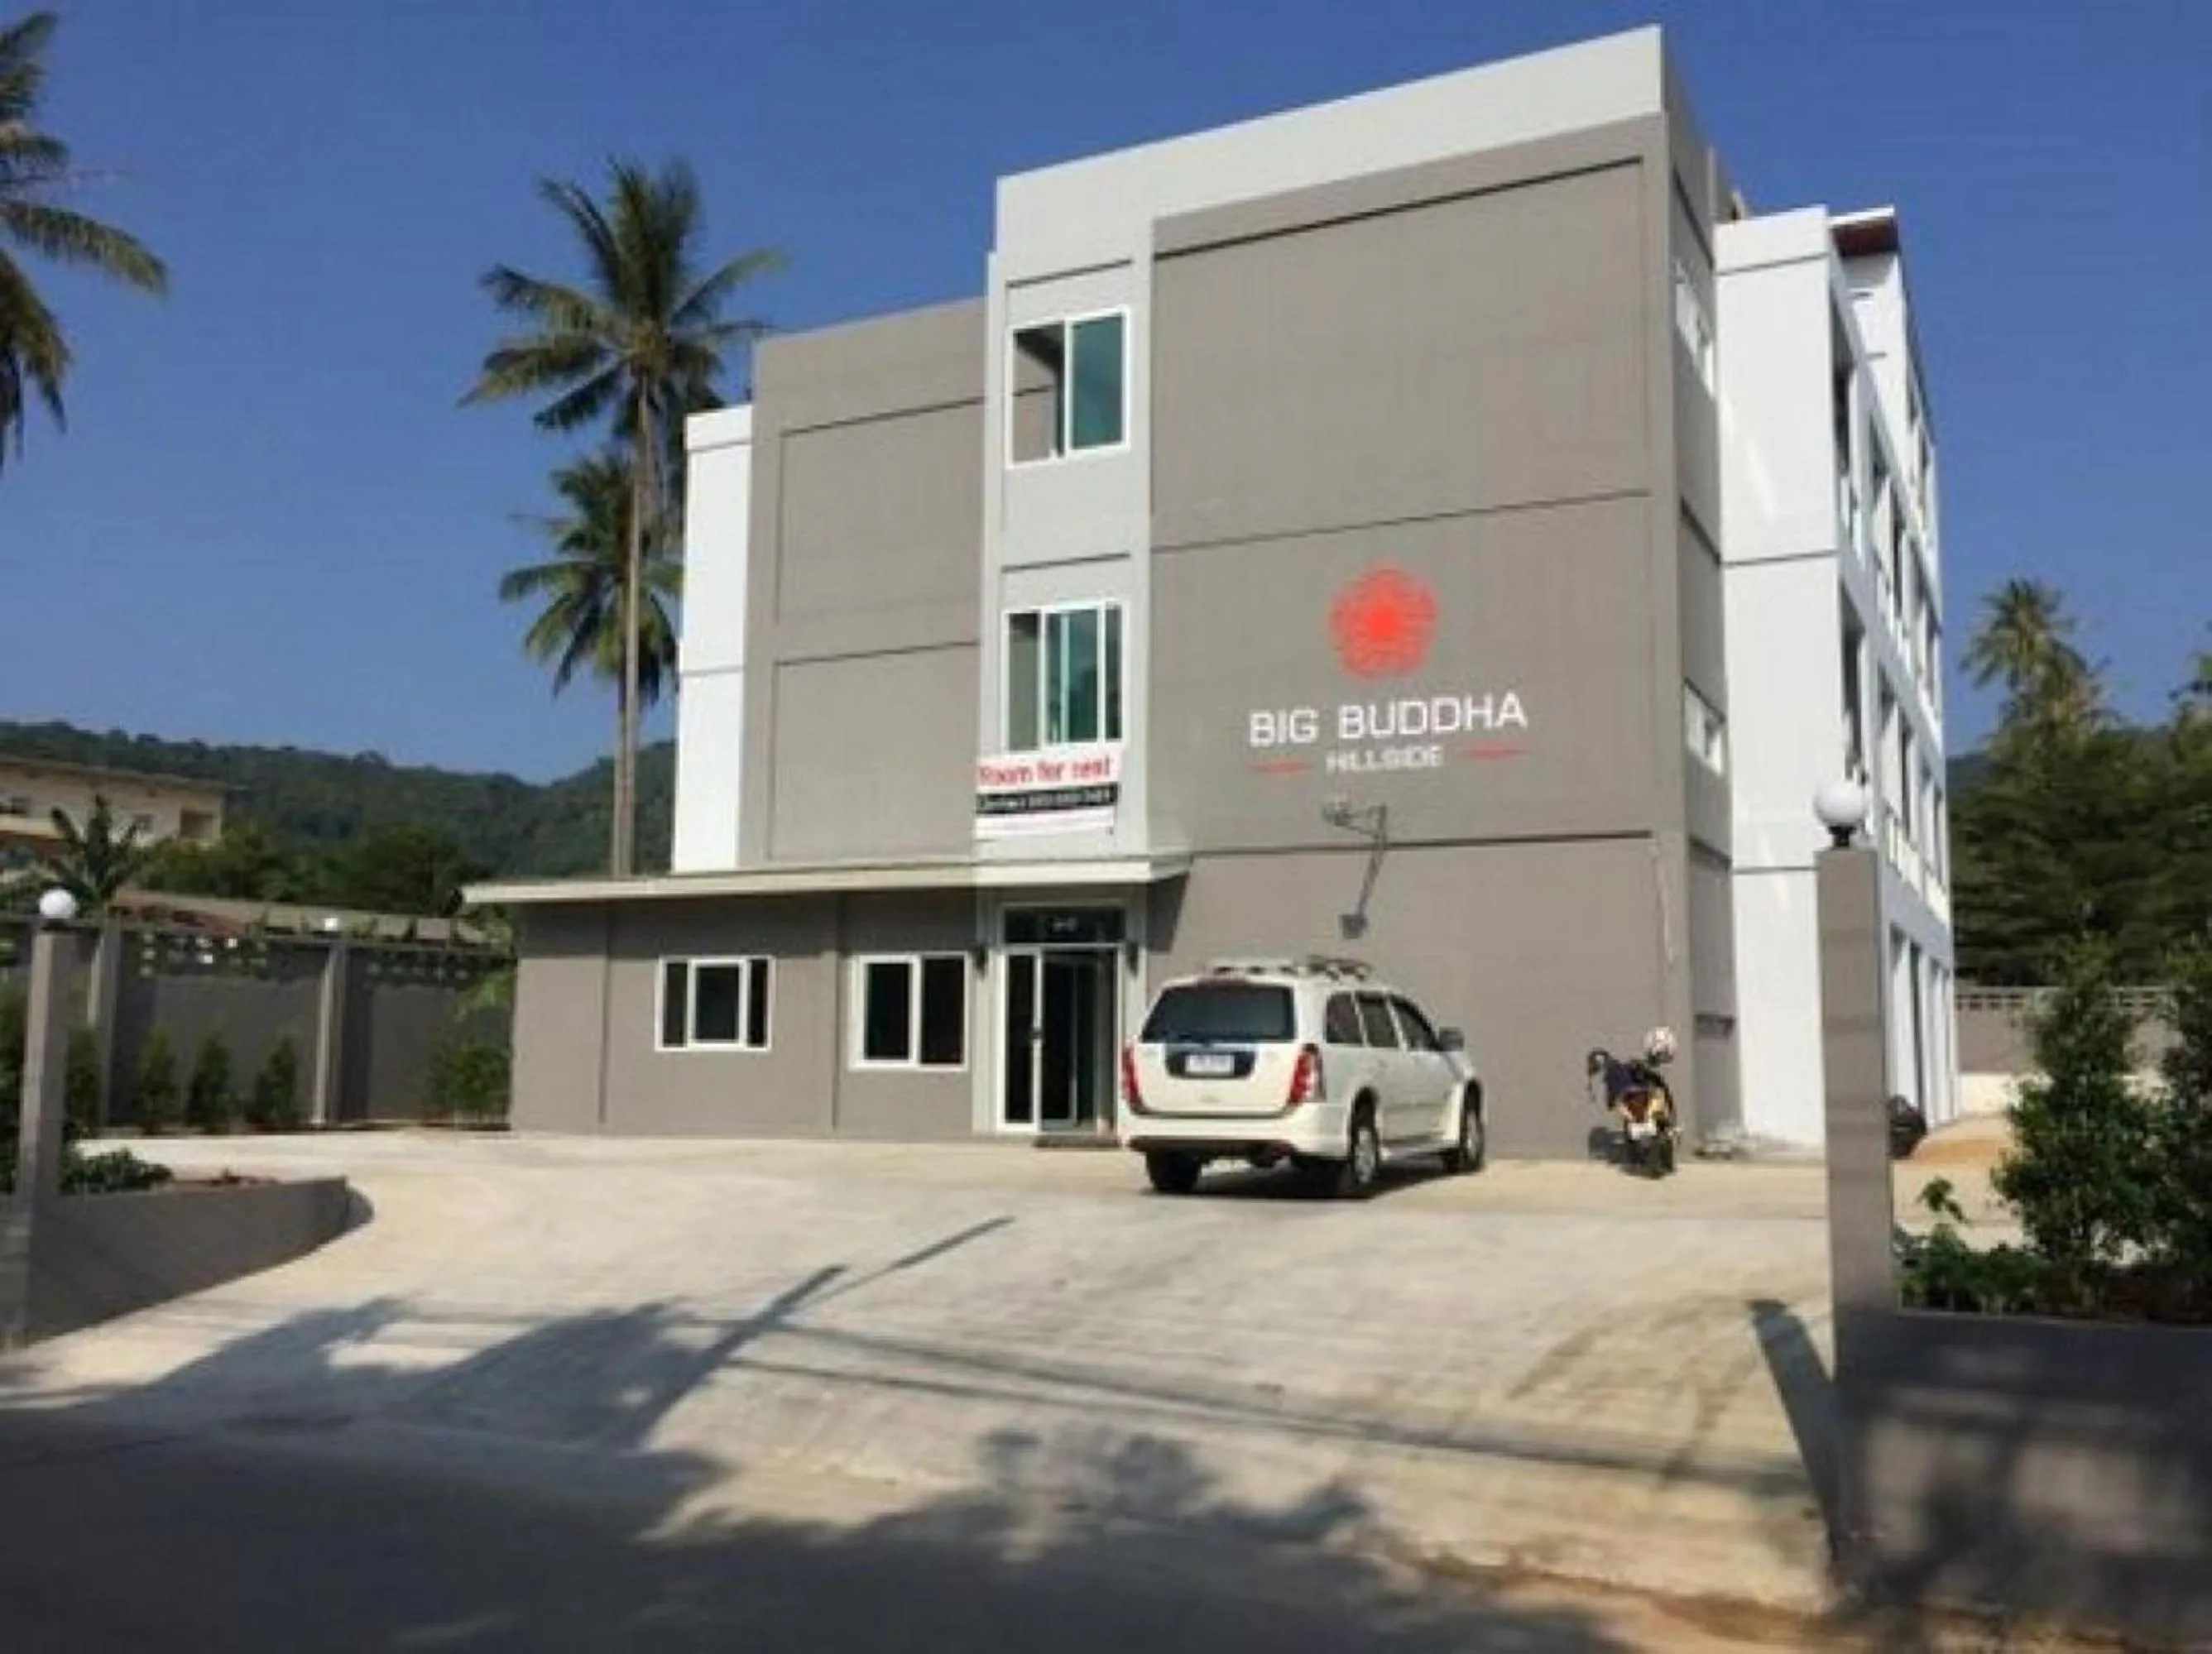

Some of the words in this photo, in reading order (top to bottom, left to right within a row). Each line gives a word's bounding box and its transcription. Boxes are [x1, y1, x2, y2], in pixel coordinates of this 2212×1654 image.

[1249, 708, 1320, 748] BIG
[1337, 690, 1528, 740] BUDDHA
[1326, 746, 1445, 774] HILLSIDE
